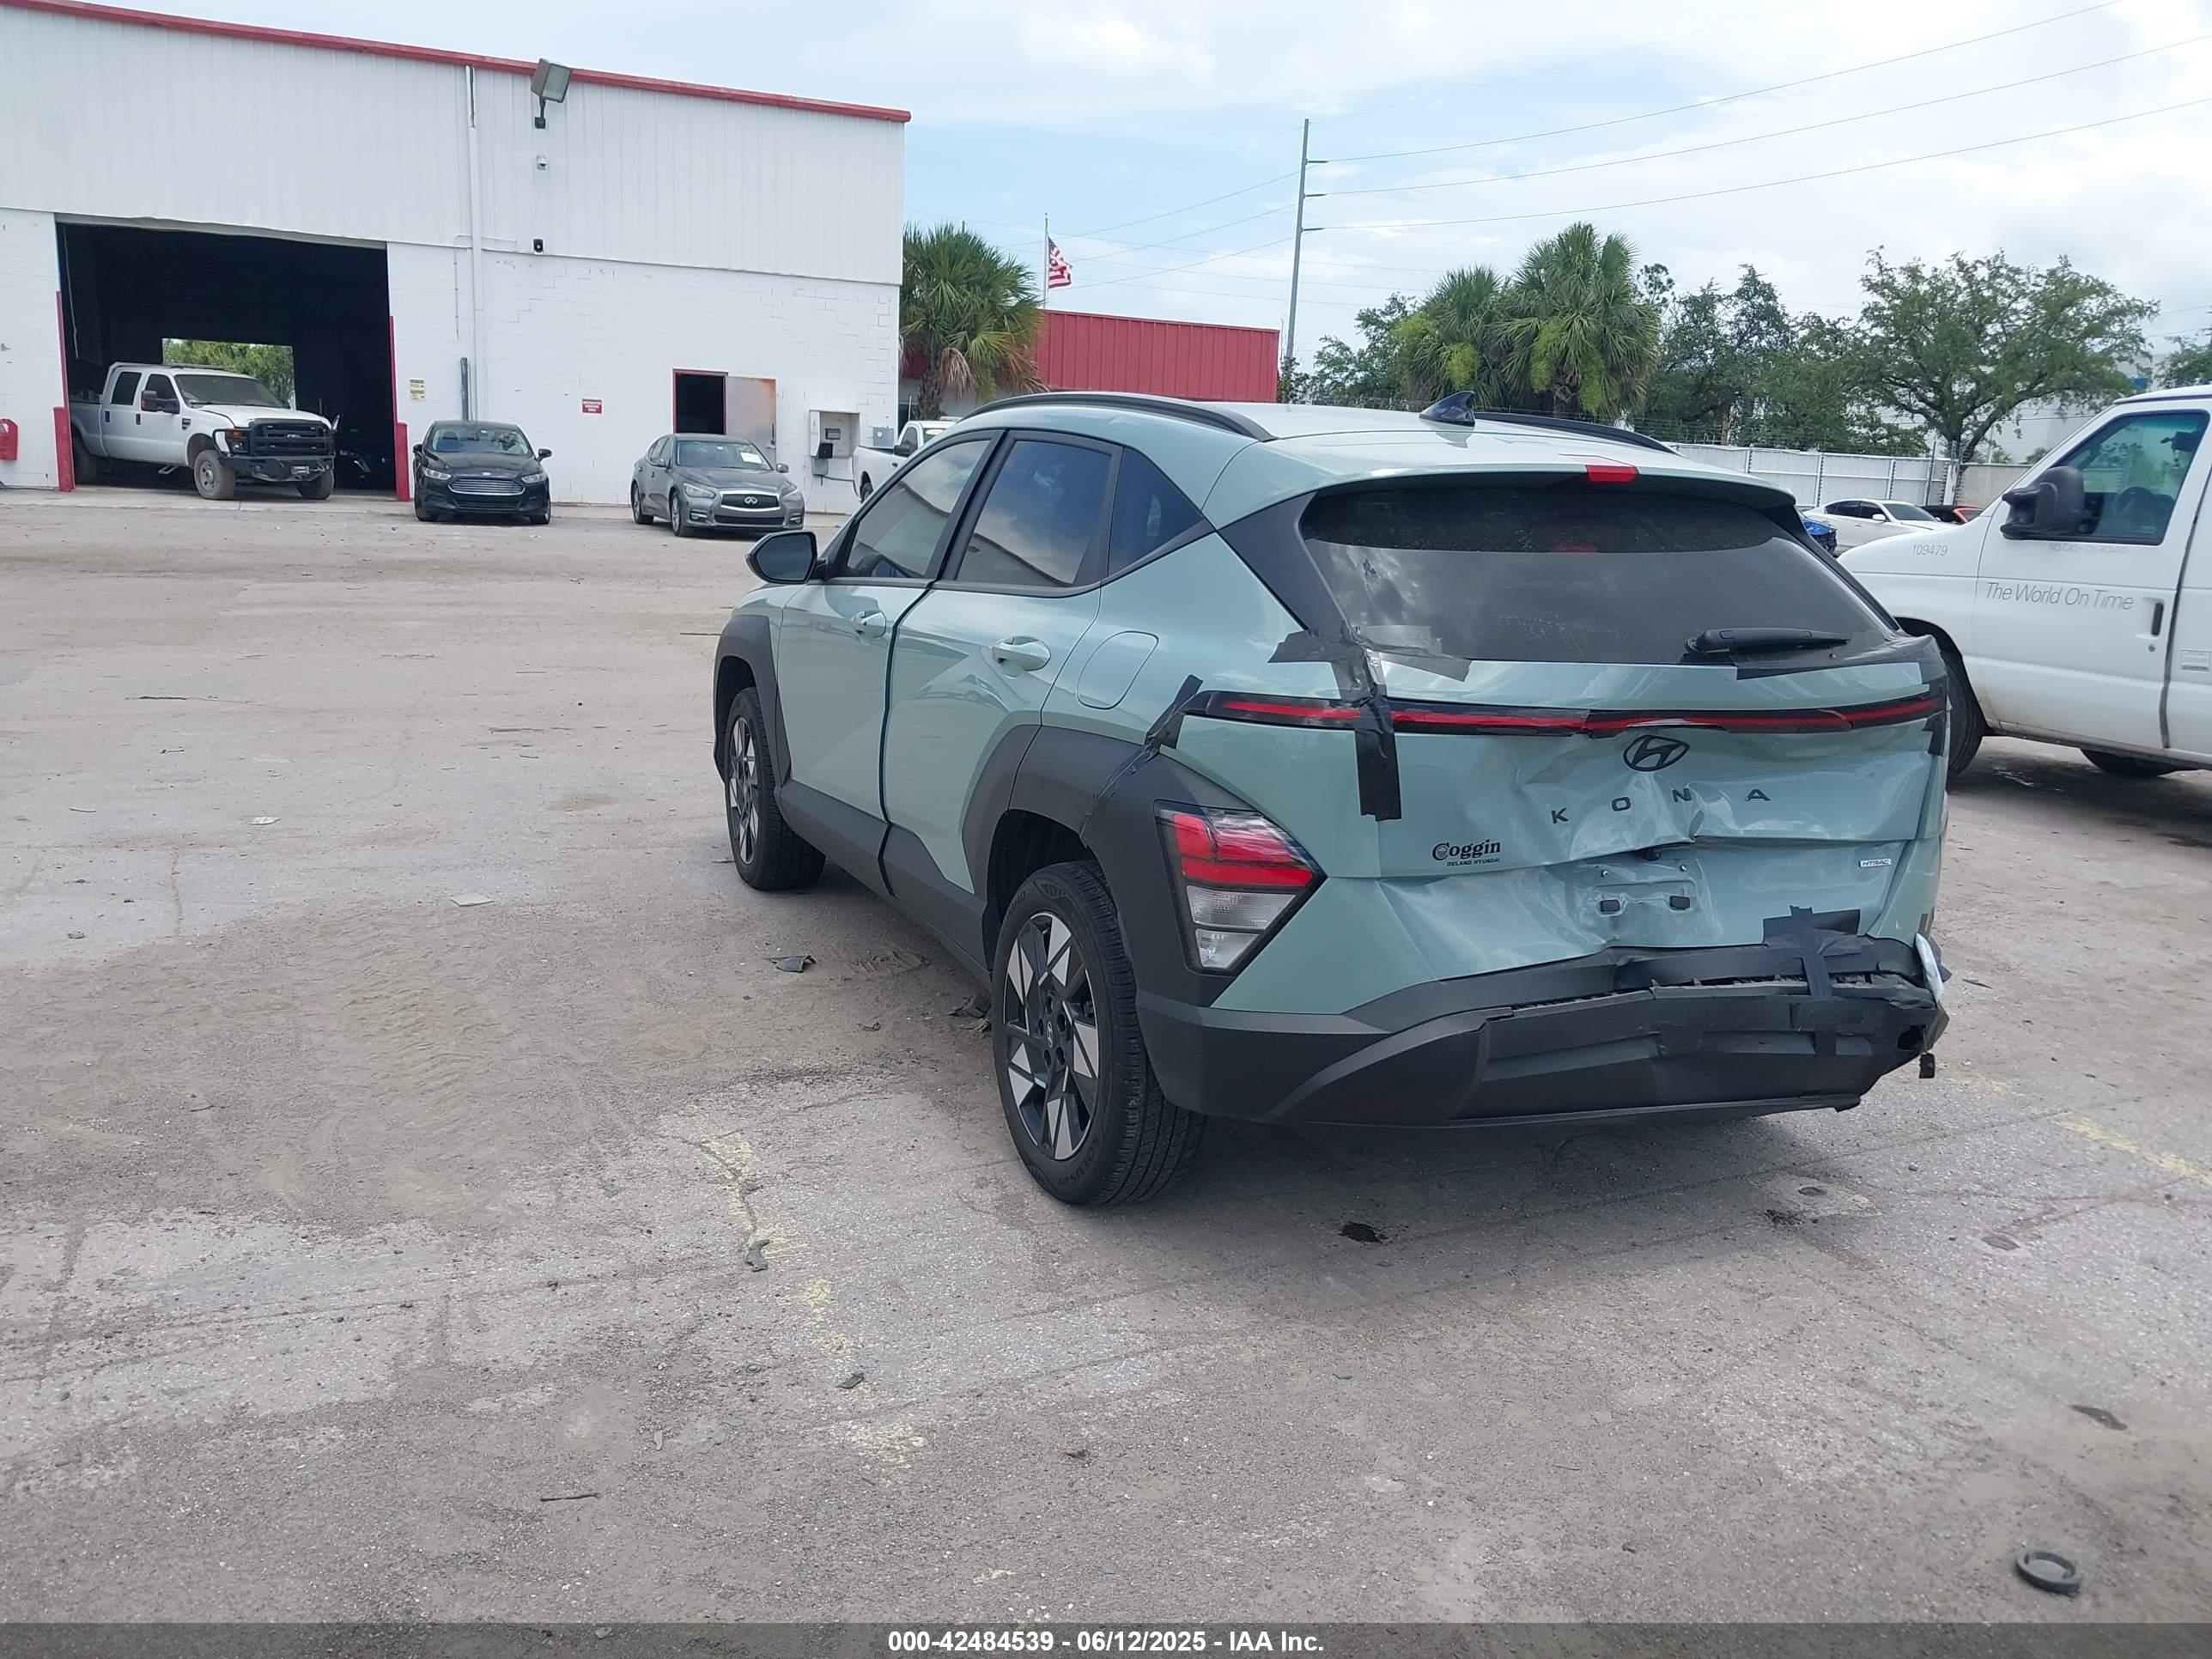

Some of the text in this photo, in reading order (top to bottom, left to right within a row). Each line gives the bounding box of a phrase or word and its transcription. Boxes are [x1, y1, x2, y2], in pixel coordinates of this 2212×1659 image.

[1911, 544, 1948, 556] 109479
[1986, 581, 2135, 611] The World On Time
[1551, 787, 1771, 824] KONA
[1431, 838, 1501, 861] Coggin
